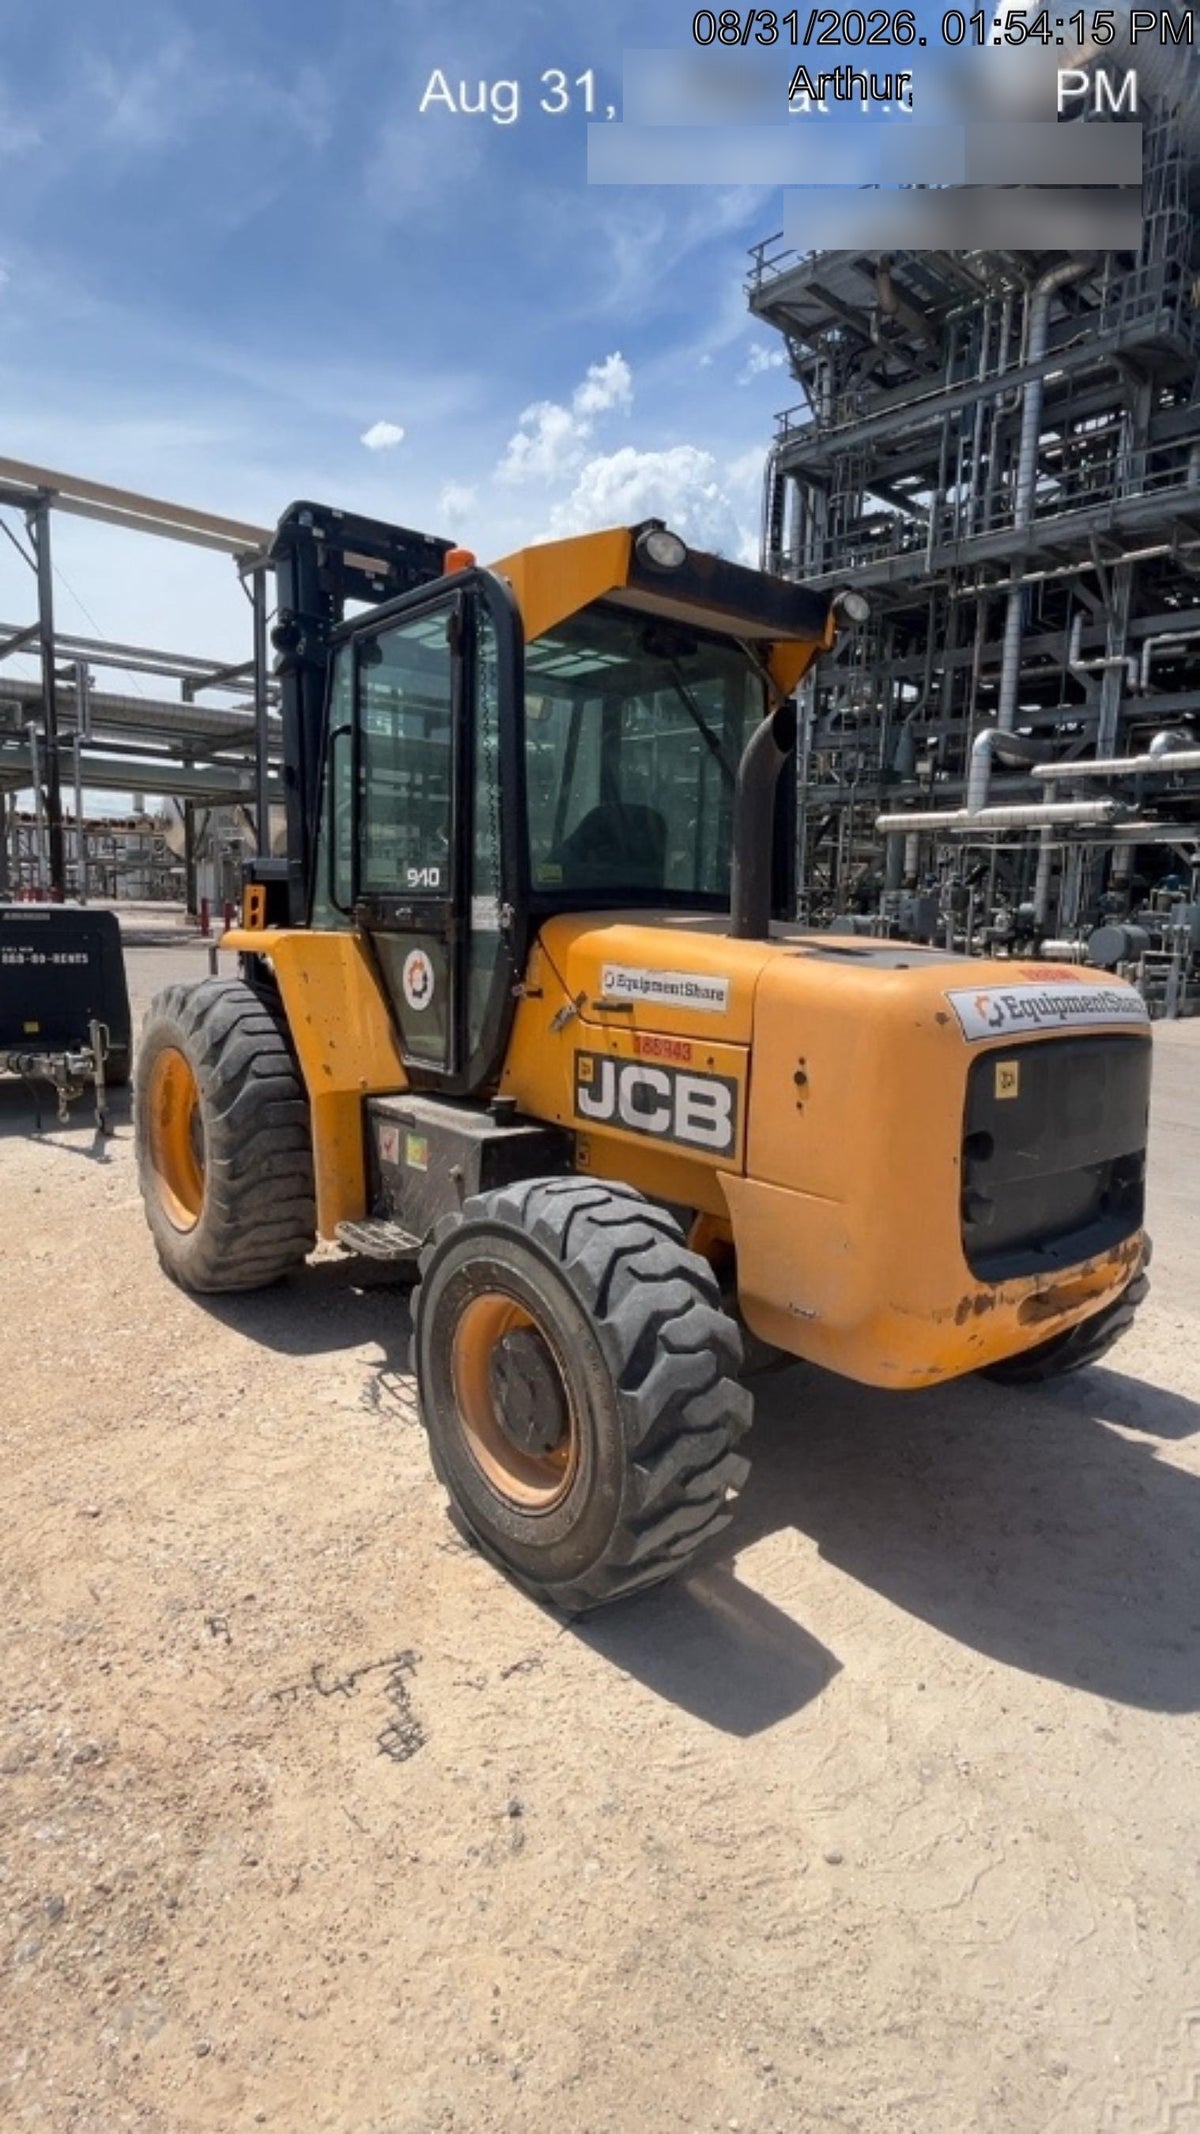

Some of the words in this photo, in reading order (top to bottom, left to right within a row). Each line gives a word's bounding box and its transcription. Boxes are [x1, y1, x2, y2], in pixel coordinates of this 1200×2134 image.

[407, 867, 440, 888] 910
[616, 974, 725, 1002] EquipmentShare
[578, 1060, 733, 1149] JCB
